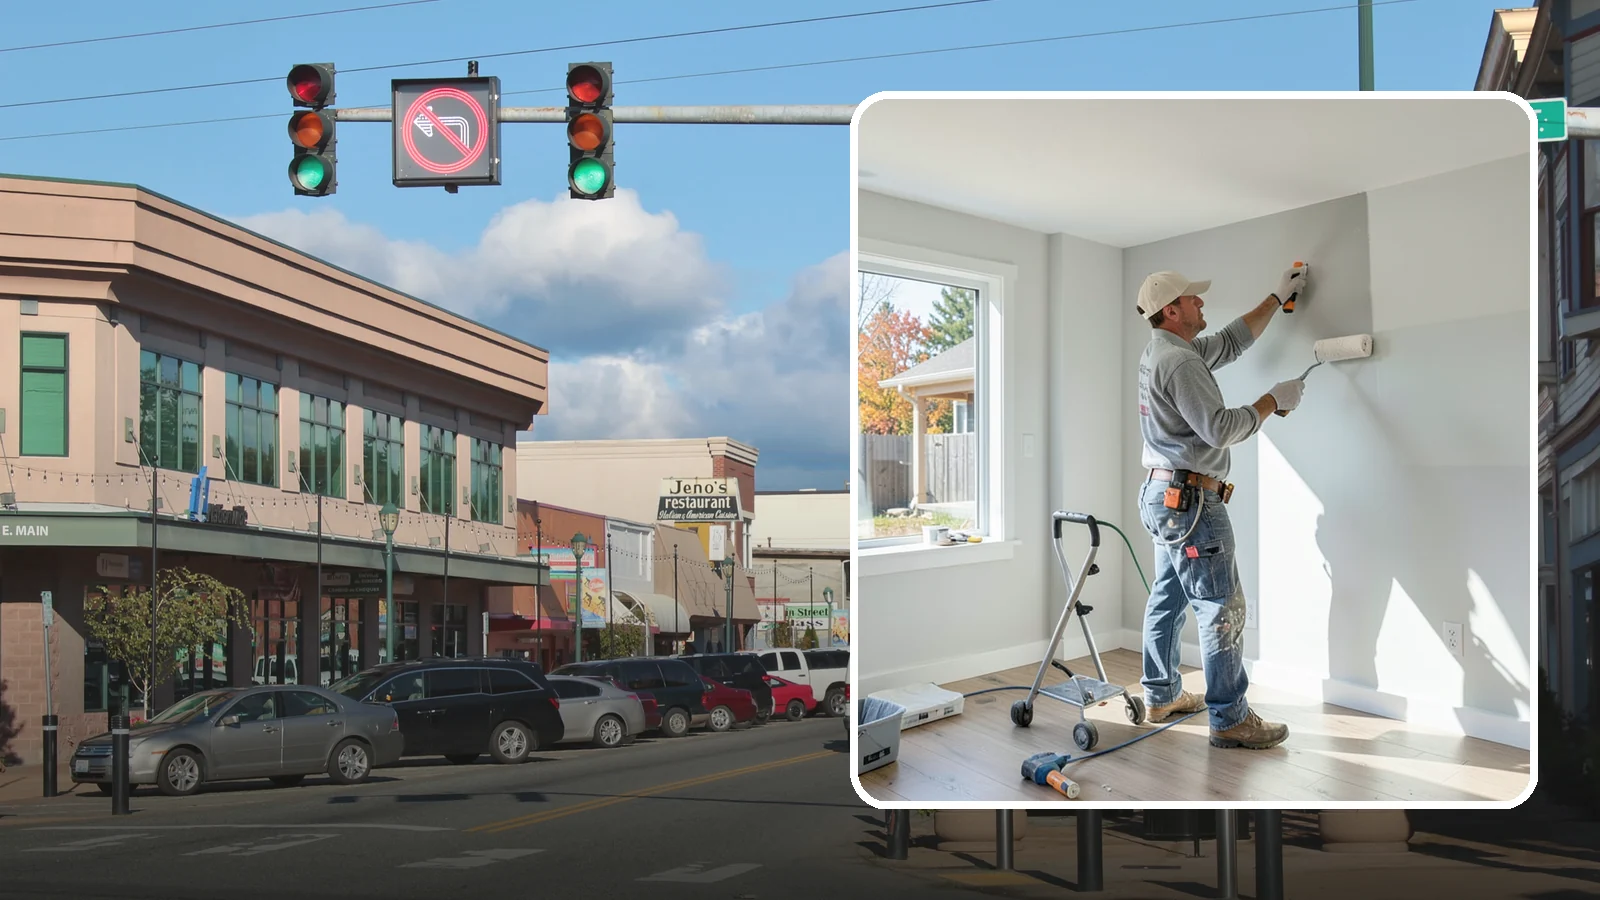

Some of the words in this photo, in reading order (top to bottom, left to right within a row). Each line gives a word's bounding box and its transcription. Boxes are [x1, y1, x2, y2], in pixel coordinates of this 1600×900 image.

[669, 480, 728, 494] Jeno's
[665, 496, 731, 509] restaurant
[658, 509, 681, 519] Italian
[686, 509, 714, 519] American
[715, 509, 738, 519] Cuisine
[2, 525, 13, 536] E.
[16, 525, 49, 536] MAIN
[785, 608, 794, 617] in
[797, 608, 829, 616] Street
[791, 619, 823, 627] lass
